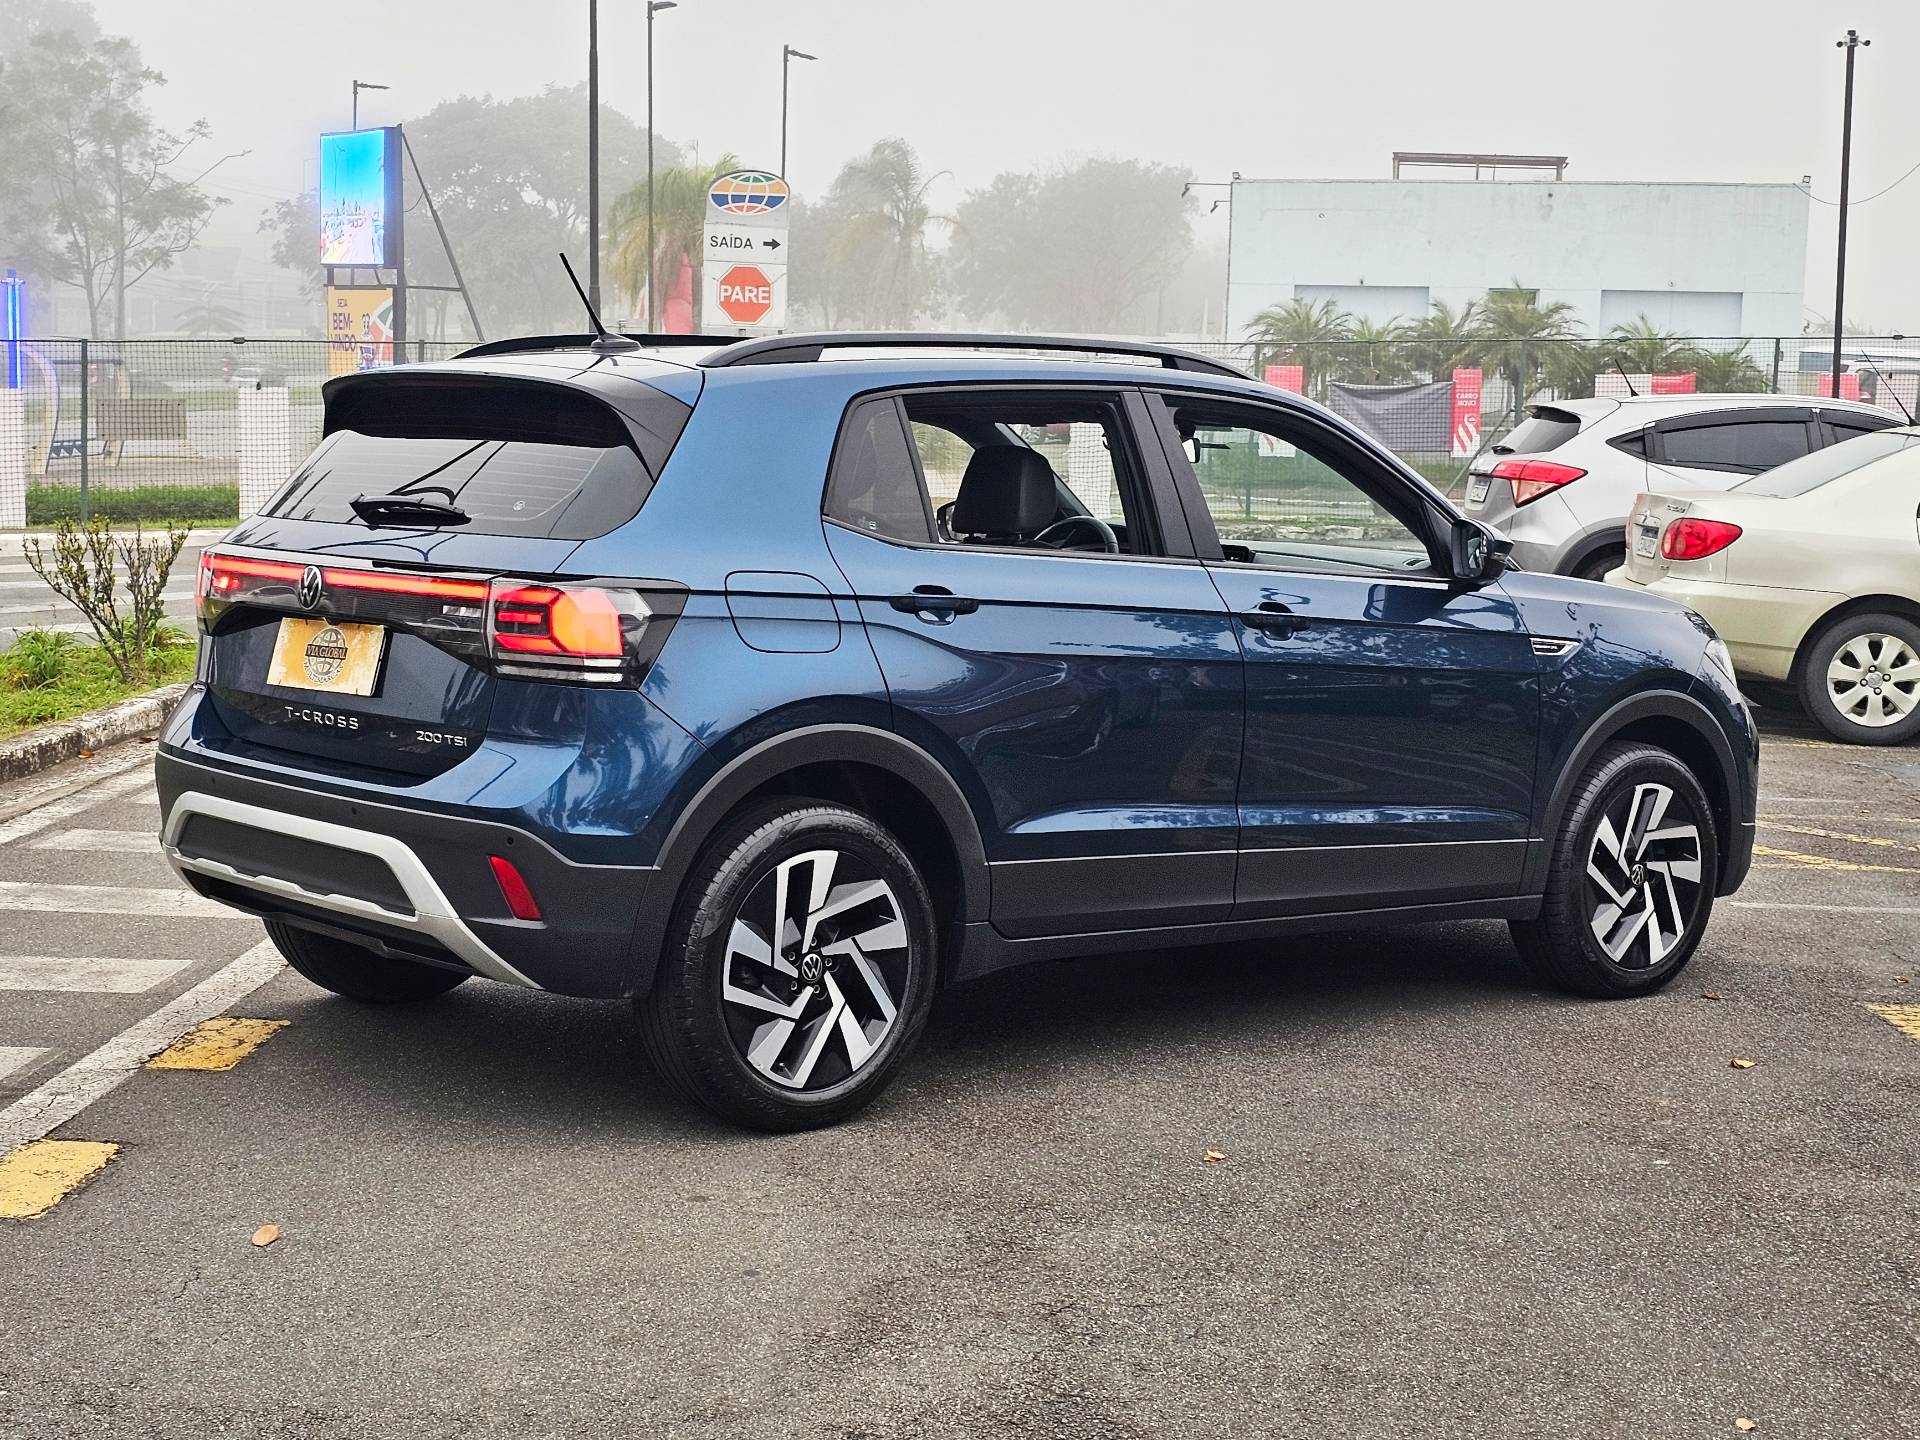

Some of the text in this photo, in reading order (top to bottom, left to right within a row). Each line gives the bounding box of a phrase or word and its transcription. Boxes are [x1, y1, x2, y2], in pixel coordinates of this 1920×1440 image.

[710, 234, 753, 250] SAÍDA
[719, 285, 770, 304] PARE
[333, 312, 353, 331] BEM-
[330, 333, 357, 353] VINDO
[1456, 392, 1479, 400] CARRO
[307, 645, 347, 659] VIA GLOBAL
[285, 706, 359, 730] T-CROSS
[415, 730, 468, 748] 200 TSI
